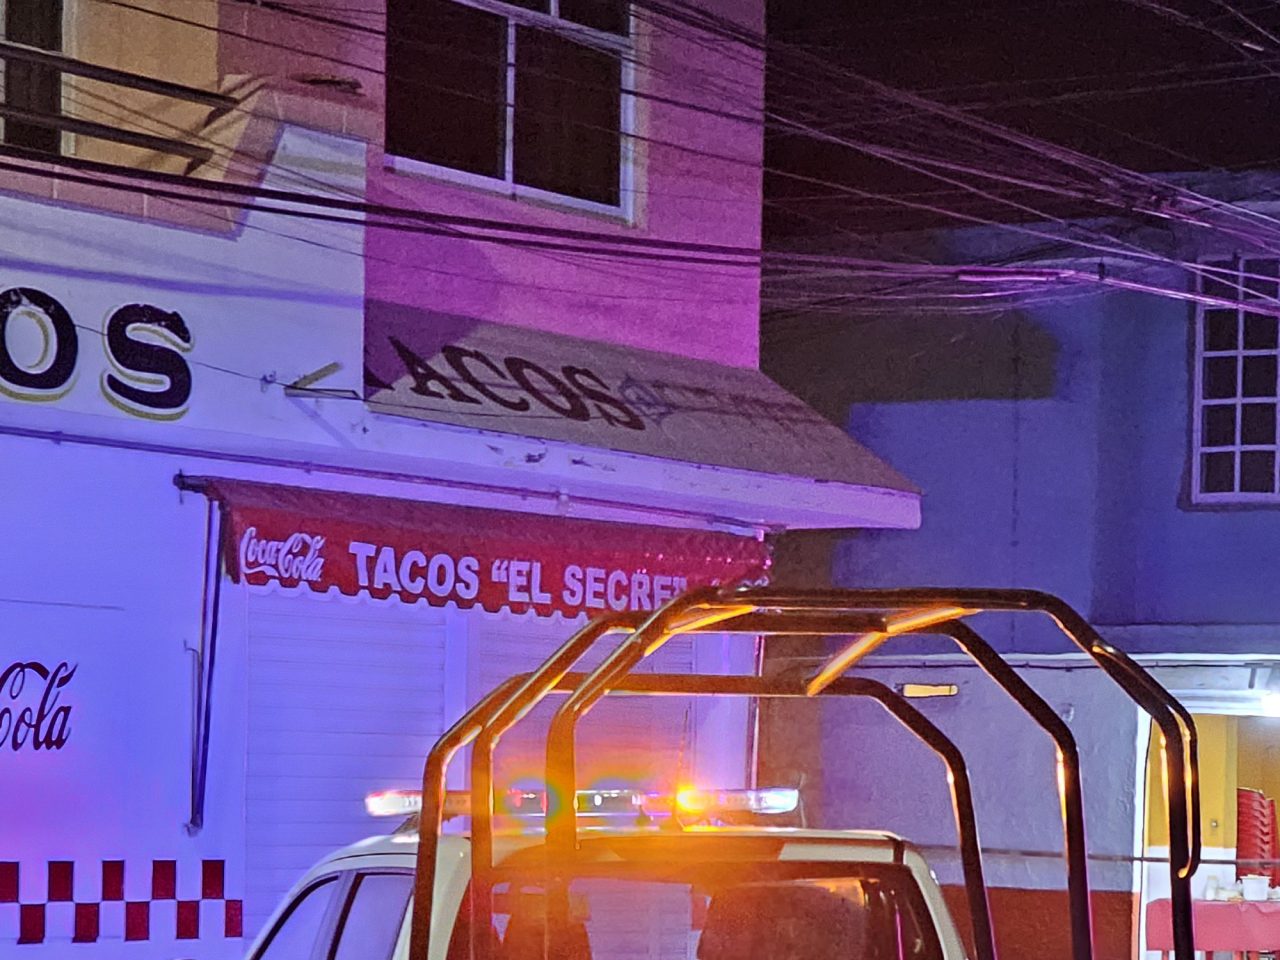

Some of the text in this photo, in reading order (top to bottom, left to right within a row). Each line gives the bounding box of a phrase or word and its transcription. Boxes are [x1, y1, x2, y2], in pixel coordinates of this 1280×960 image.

[364, 336, 647, 431] ACOS
[240, 527, 326, 581] Coca-Cola
[349, 541, 479, 599] TACOS
